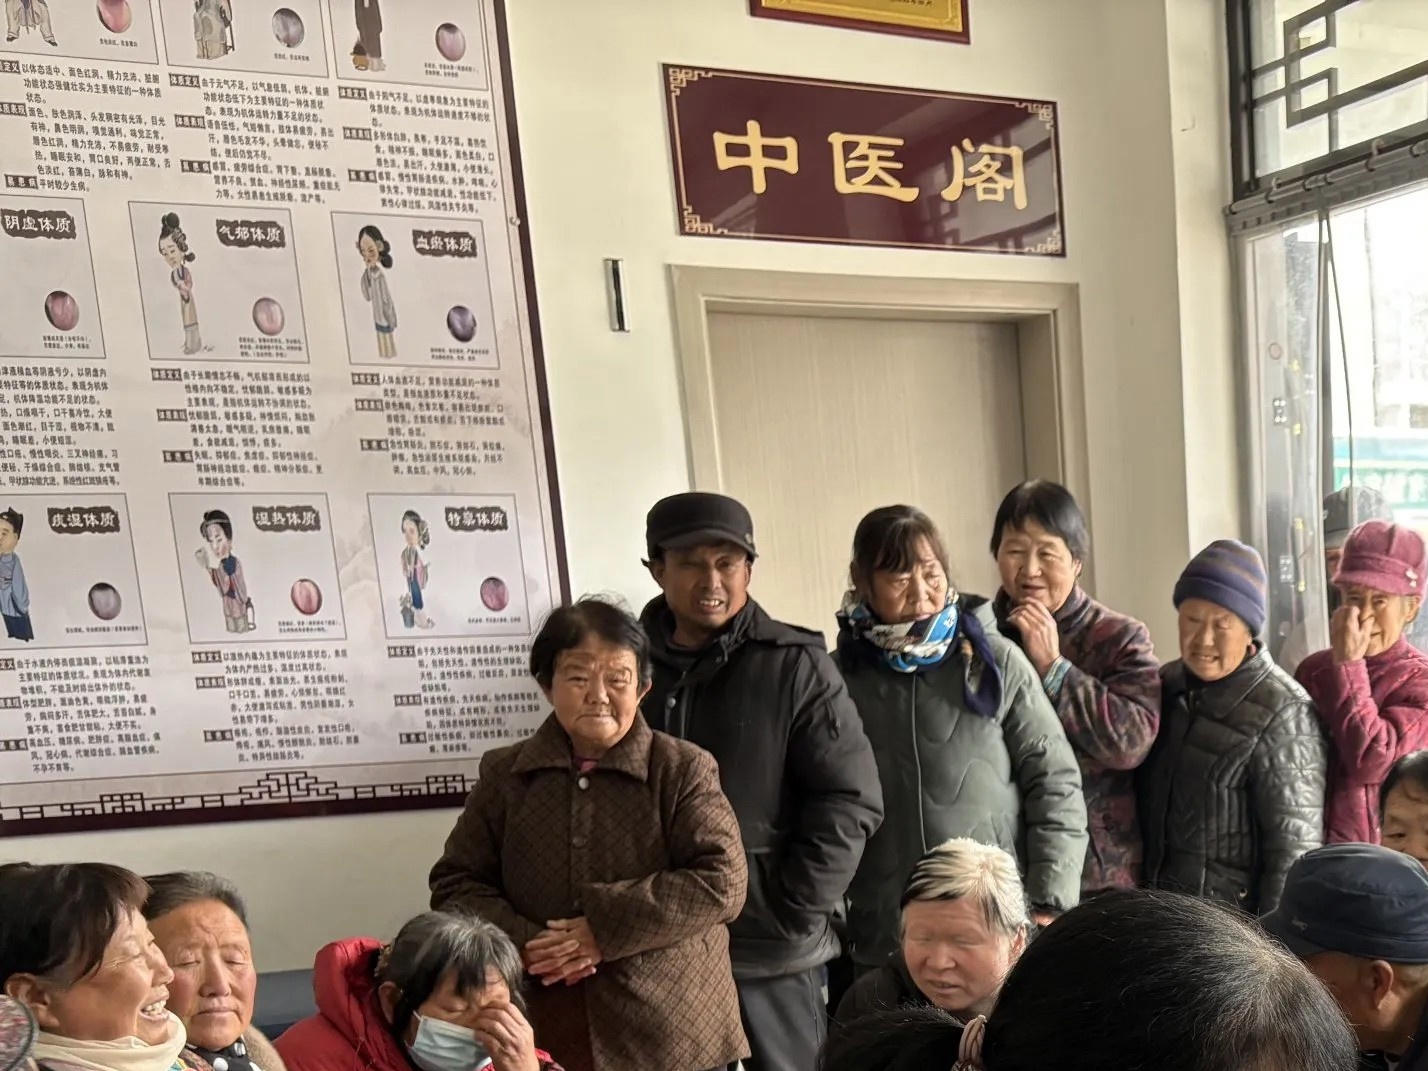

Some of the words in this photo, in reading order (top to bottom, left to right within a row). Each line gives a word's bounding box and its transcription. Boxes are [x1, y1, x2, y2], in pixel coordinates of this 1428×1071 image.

[713, 119, 1028, 209] 中医阁
[4, 215, 71, 232] 阴虚体质
[219, 225, 282, 242] 气郁体质
[256, 511, 316, 526] 湿热体质
